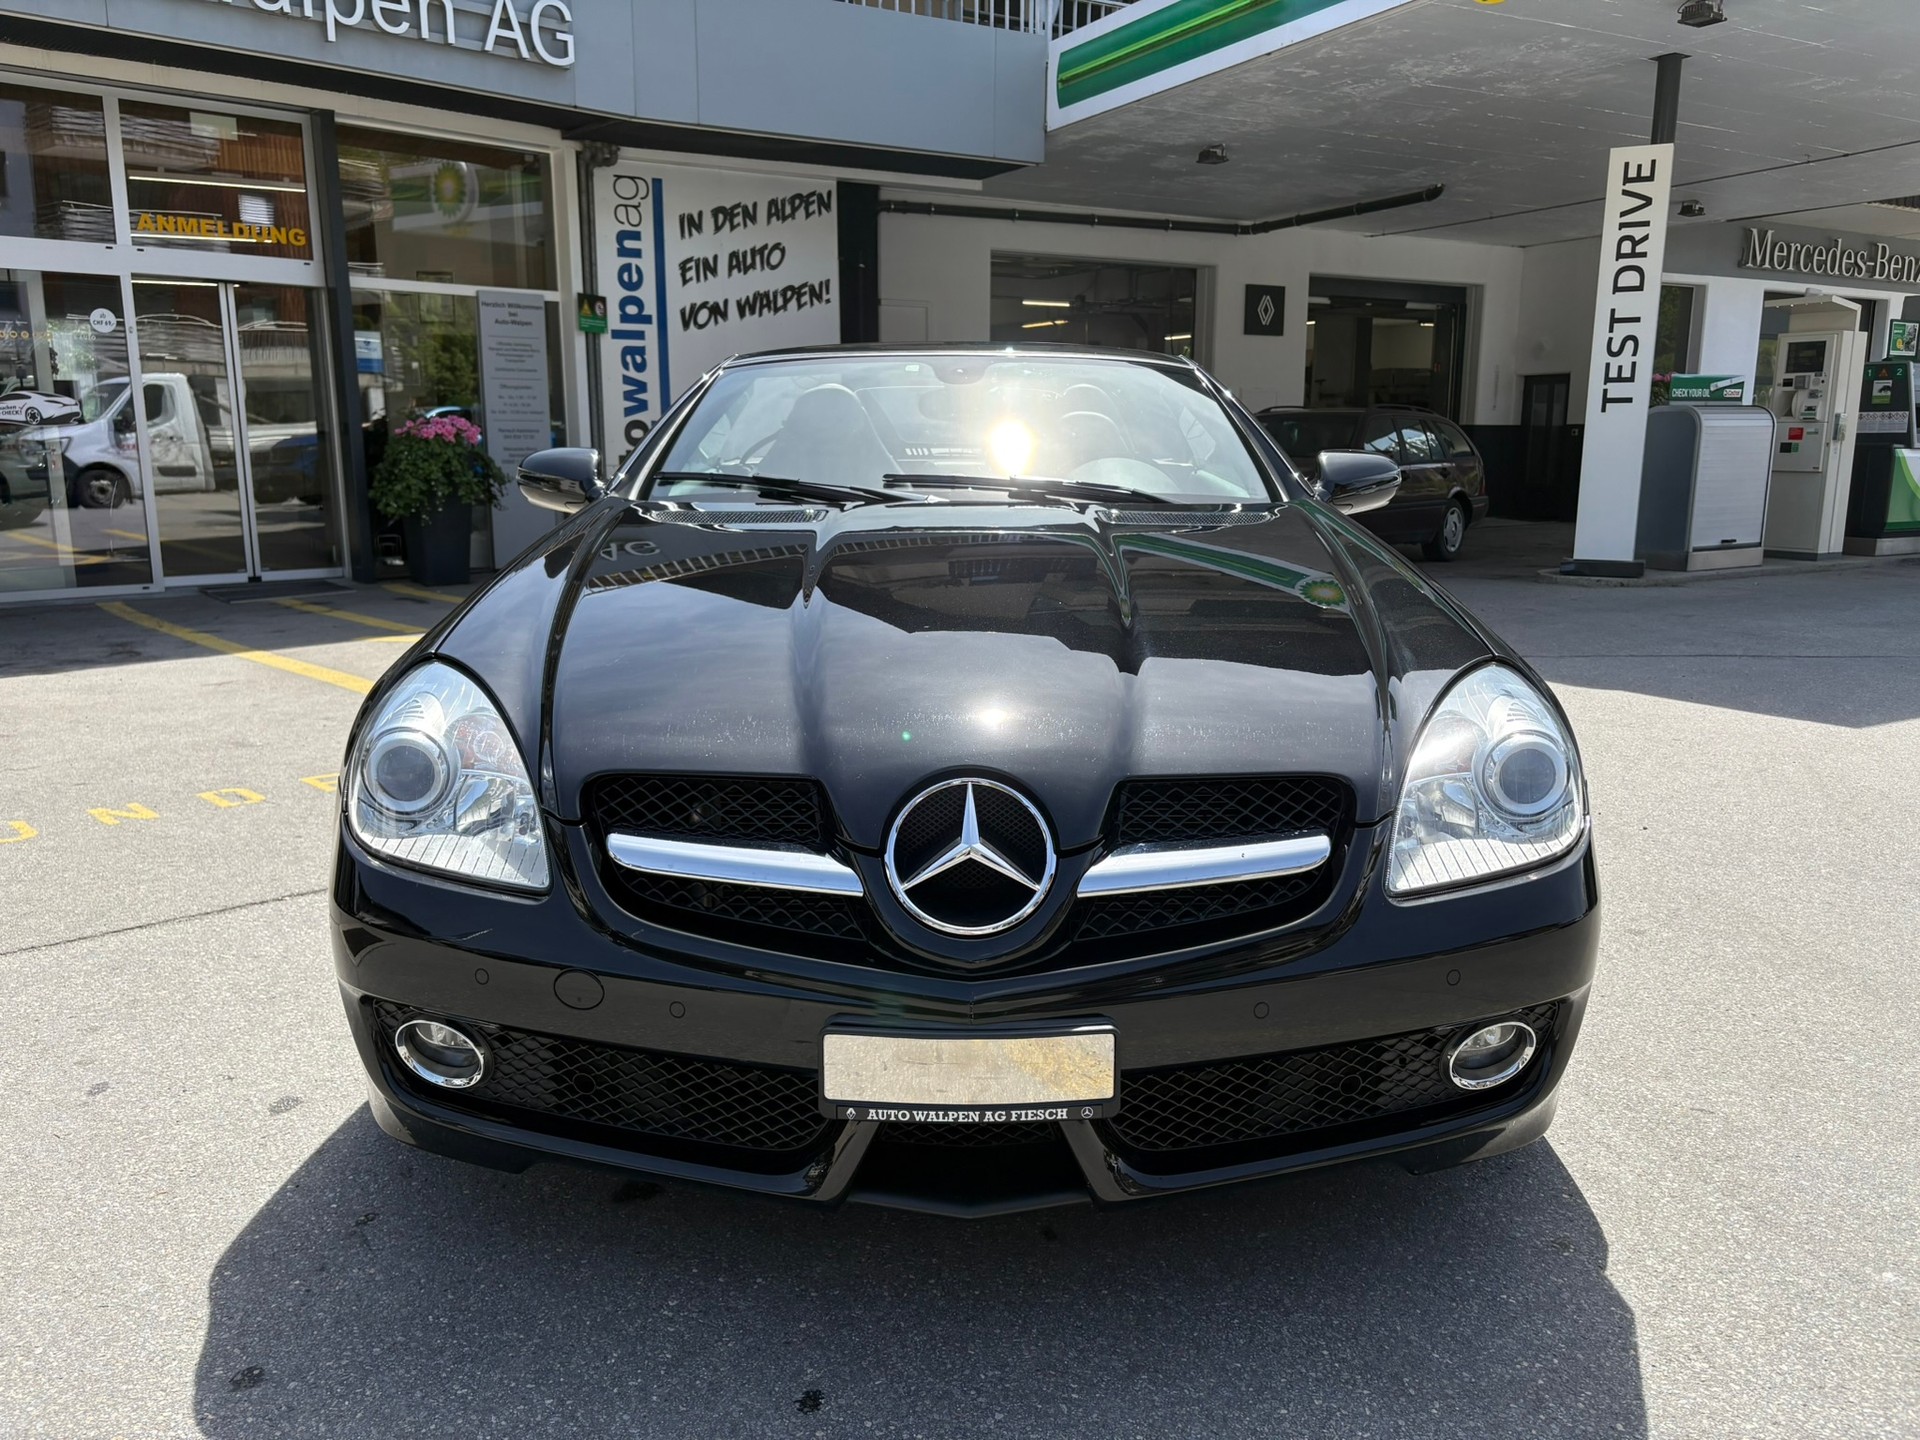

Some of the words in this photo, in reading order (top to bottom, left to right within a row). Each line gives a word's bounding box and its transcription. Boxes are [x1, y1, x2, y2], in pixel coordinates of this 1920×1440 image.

[484, 0, 576, 67] AG
[137, 212, 307, 248] ANMELDUNG
[678, 210, 704, 240] IN
[711, 202, 758, 235] DEN
[766, 190, 832, 226] ALPEN
[1612, 158, 1657, 296] DRIVE
[678, 254, 718, 287] EIN
[728, 242, 786, 278] AUTO
[680, 298, 729, 332] VON
[736, 279, 832, 320] WALPEN!
[1600, 307, 1642, 414] TEST
[1867, 369, 1872, 377] 1
[1897, 368, 1903, 376] 2
[1672, 389, 1688, 398] CHECK
[1689, 389, 1702, 398] YOUR
[1703, 389, 1711, 398] OIL
[867, 1107, 910, 1122] AUTO
[912, 1109, 980, 1123] WALPEN
[983, 1109, 1007, 1123] AG
[1010, 1107, 1069, 1122] FIESCH
